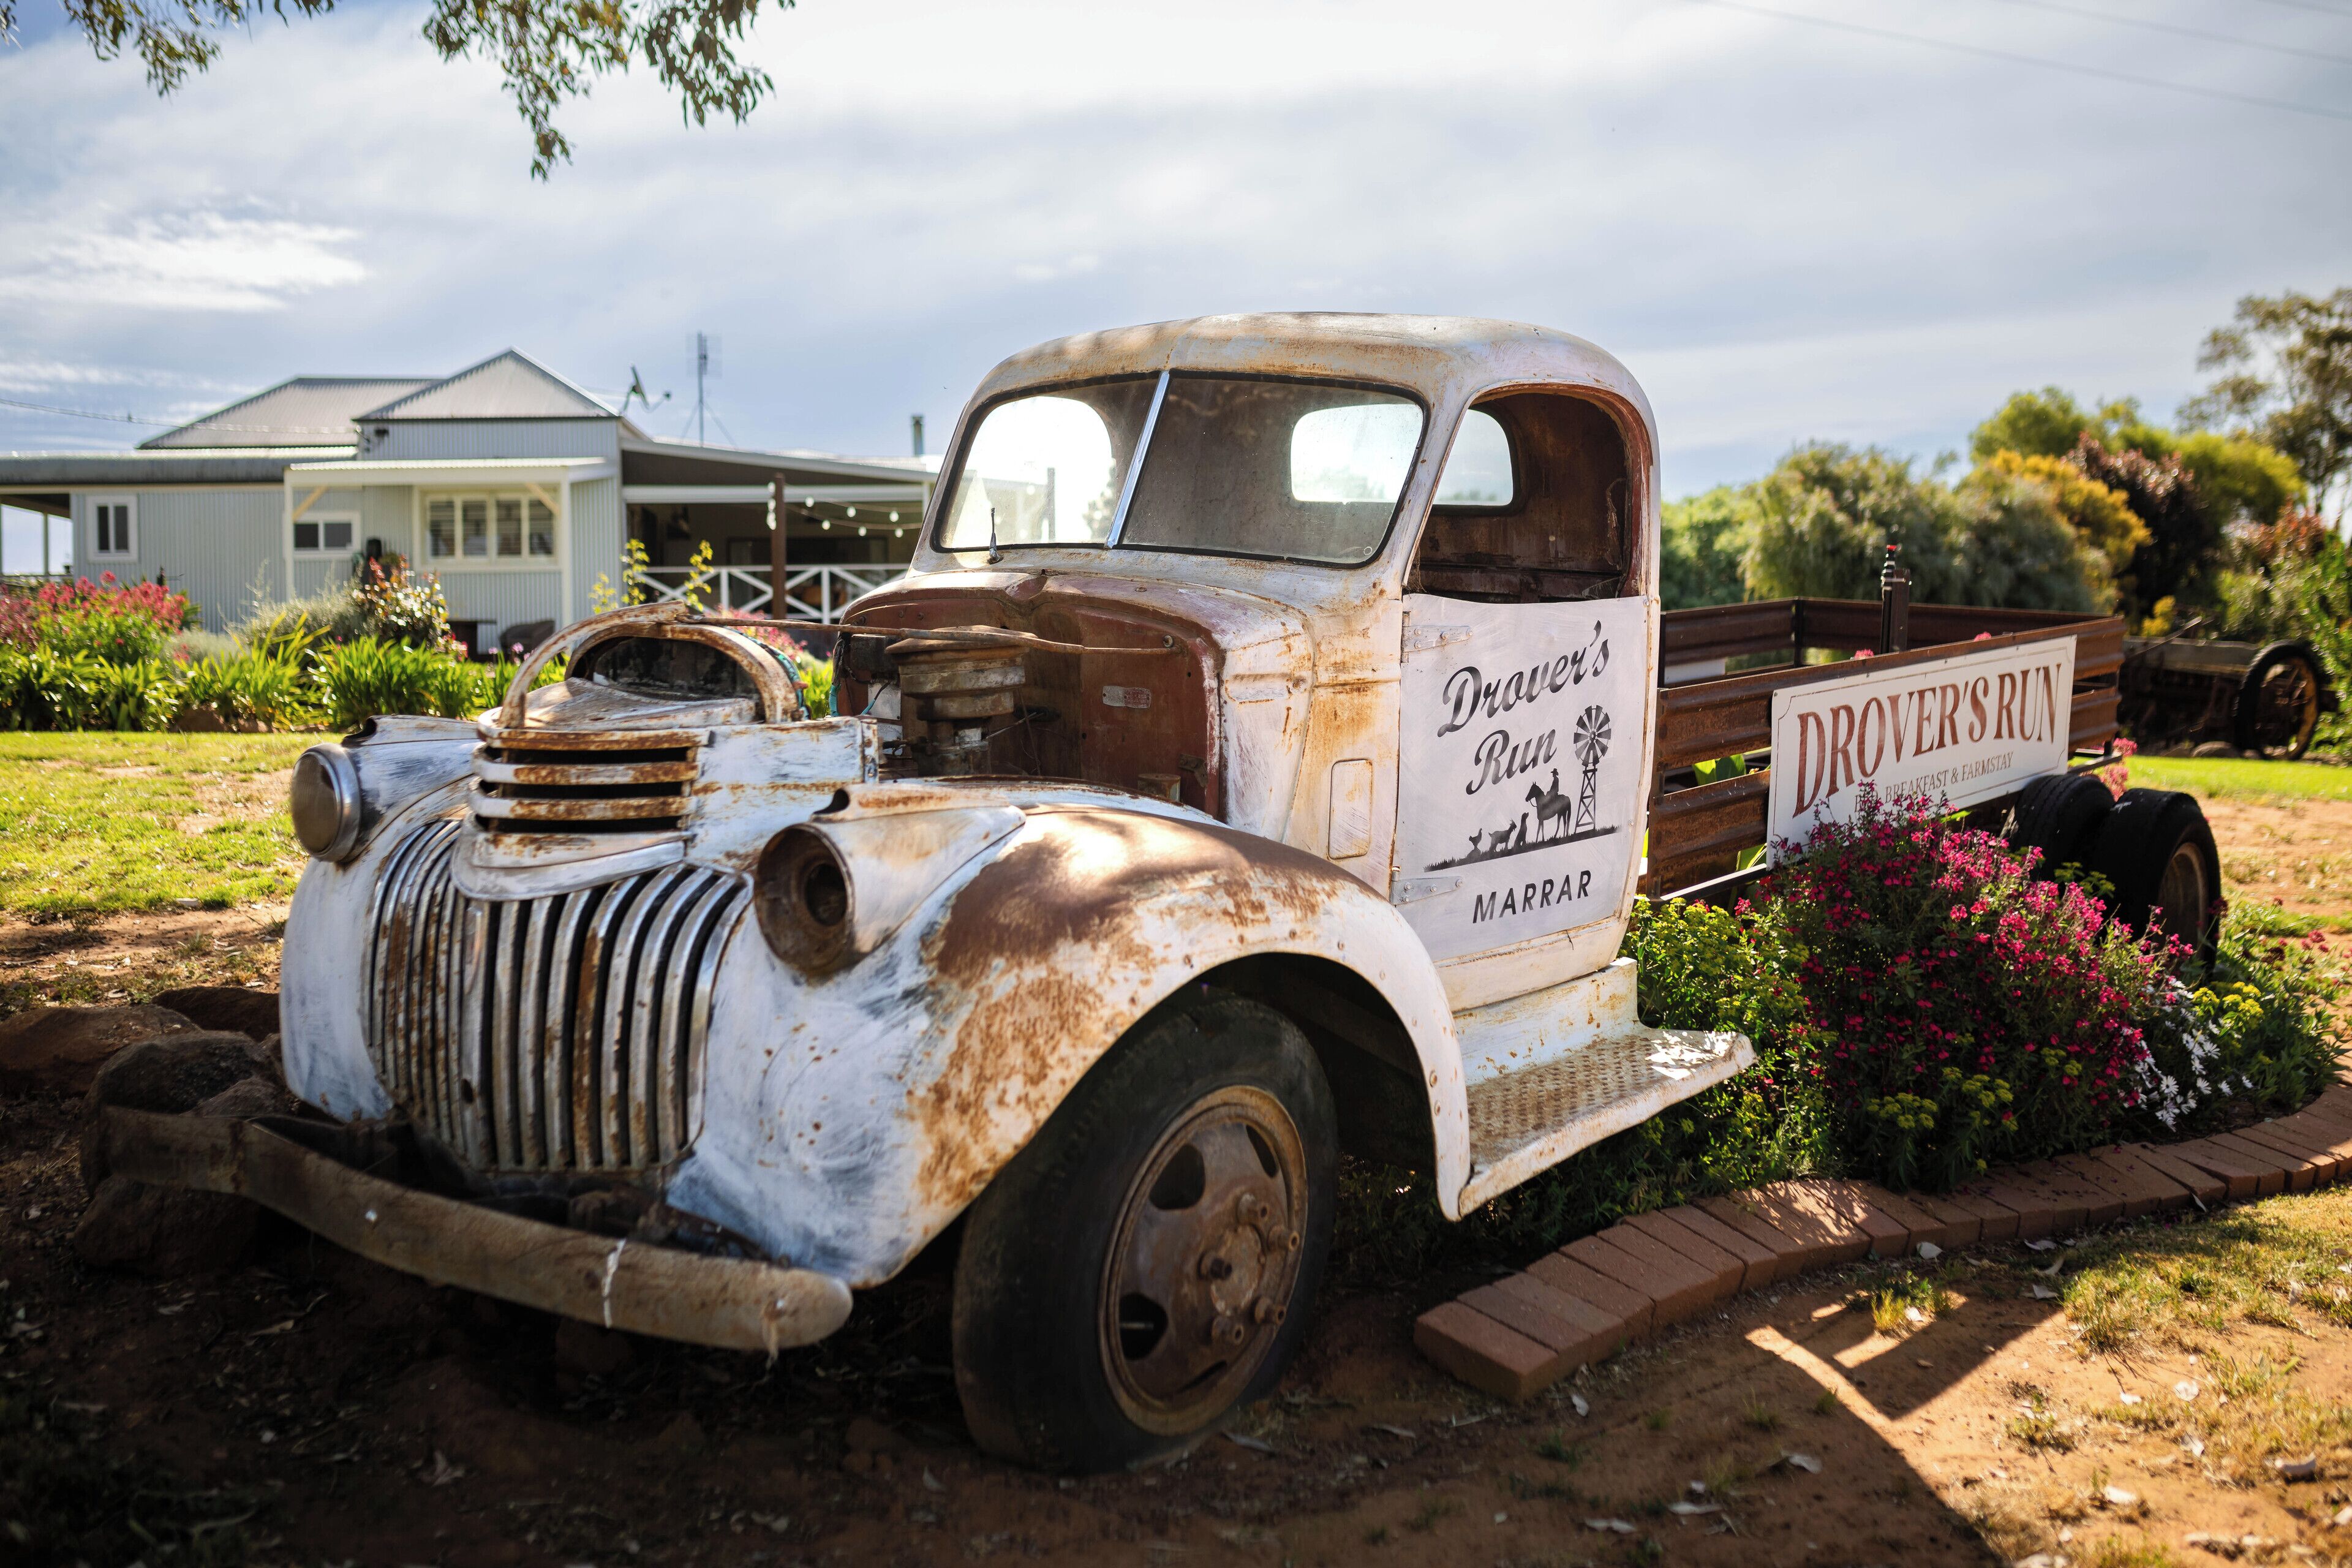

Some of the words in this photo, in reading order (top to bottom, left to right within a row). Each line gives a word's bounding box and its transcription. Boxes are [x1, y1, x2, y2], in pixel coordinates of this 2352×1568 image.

[1437, 620, 1609, 737] Drover's
[1465, 728, 1558, 796] Run
[1792, 676, 1989, 820] DROVER'S
[1993, 662, 2062, 744] RUN
[1951, 766, 1959, 784] &
[1961, 750, 2015, 782] FARMSTAY
[1472, 870, 1592, 924] MARRAR
